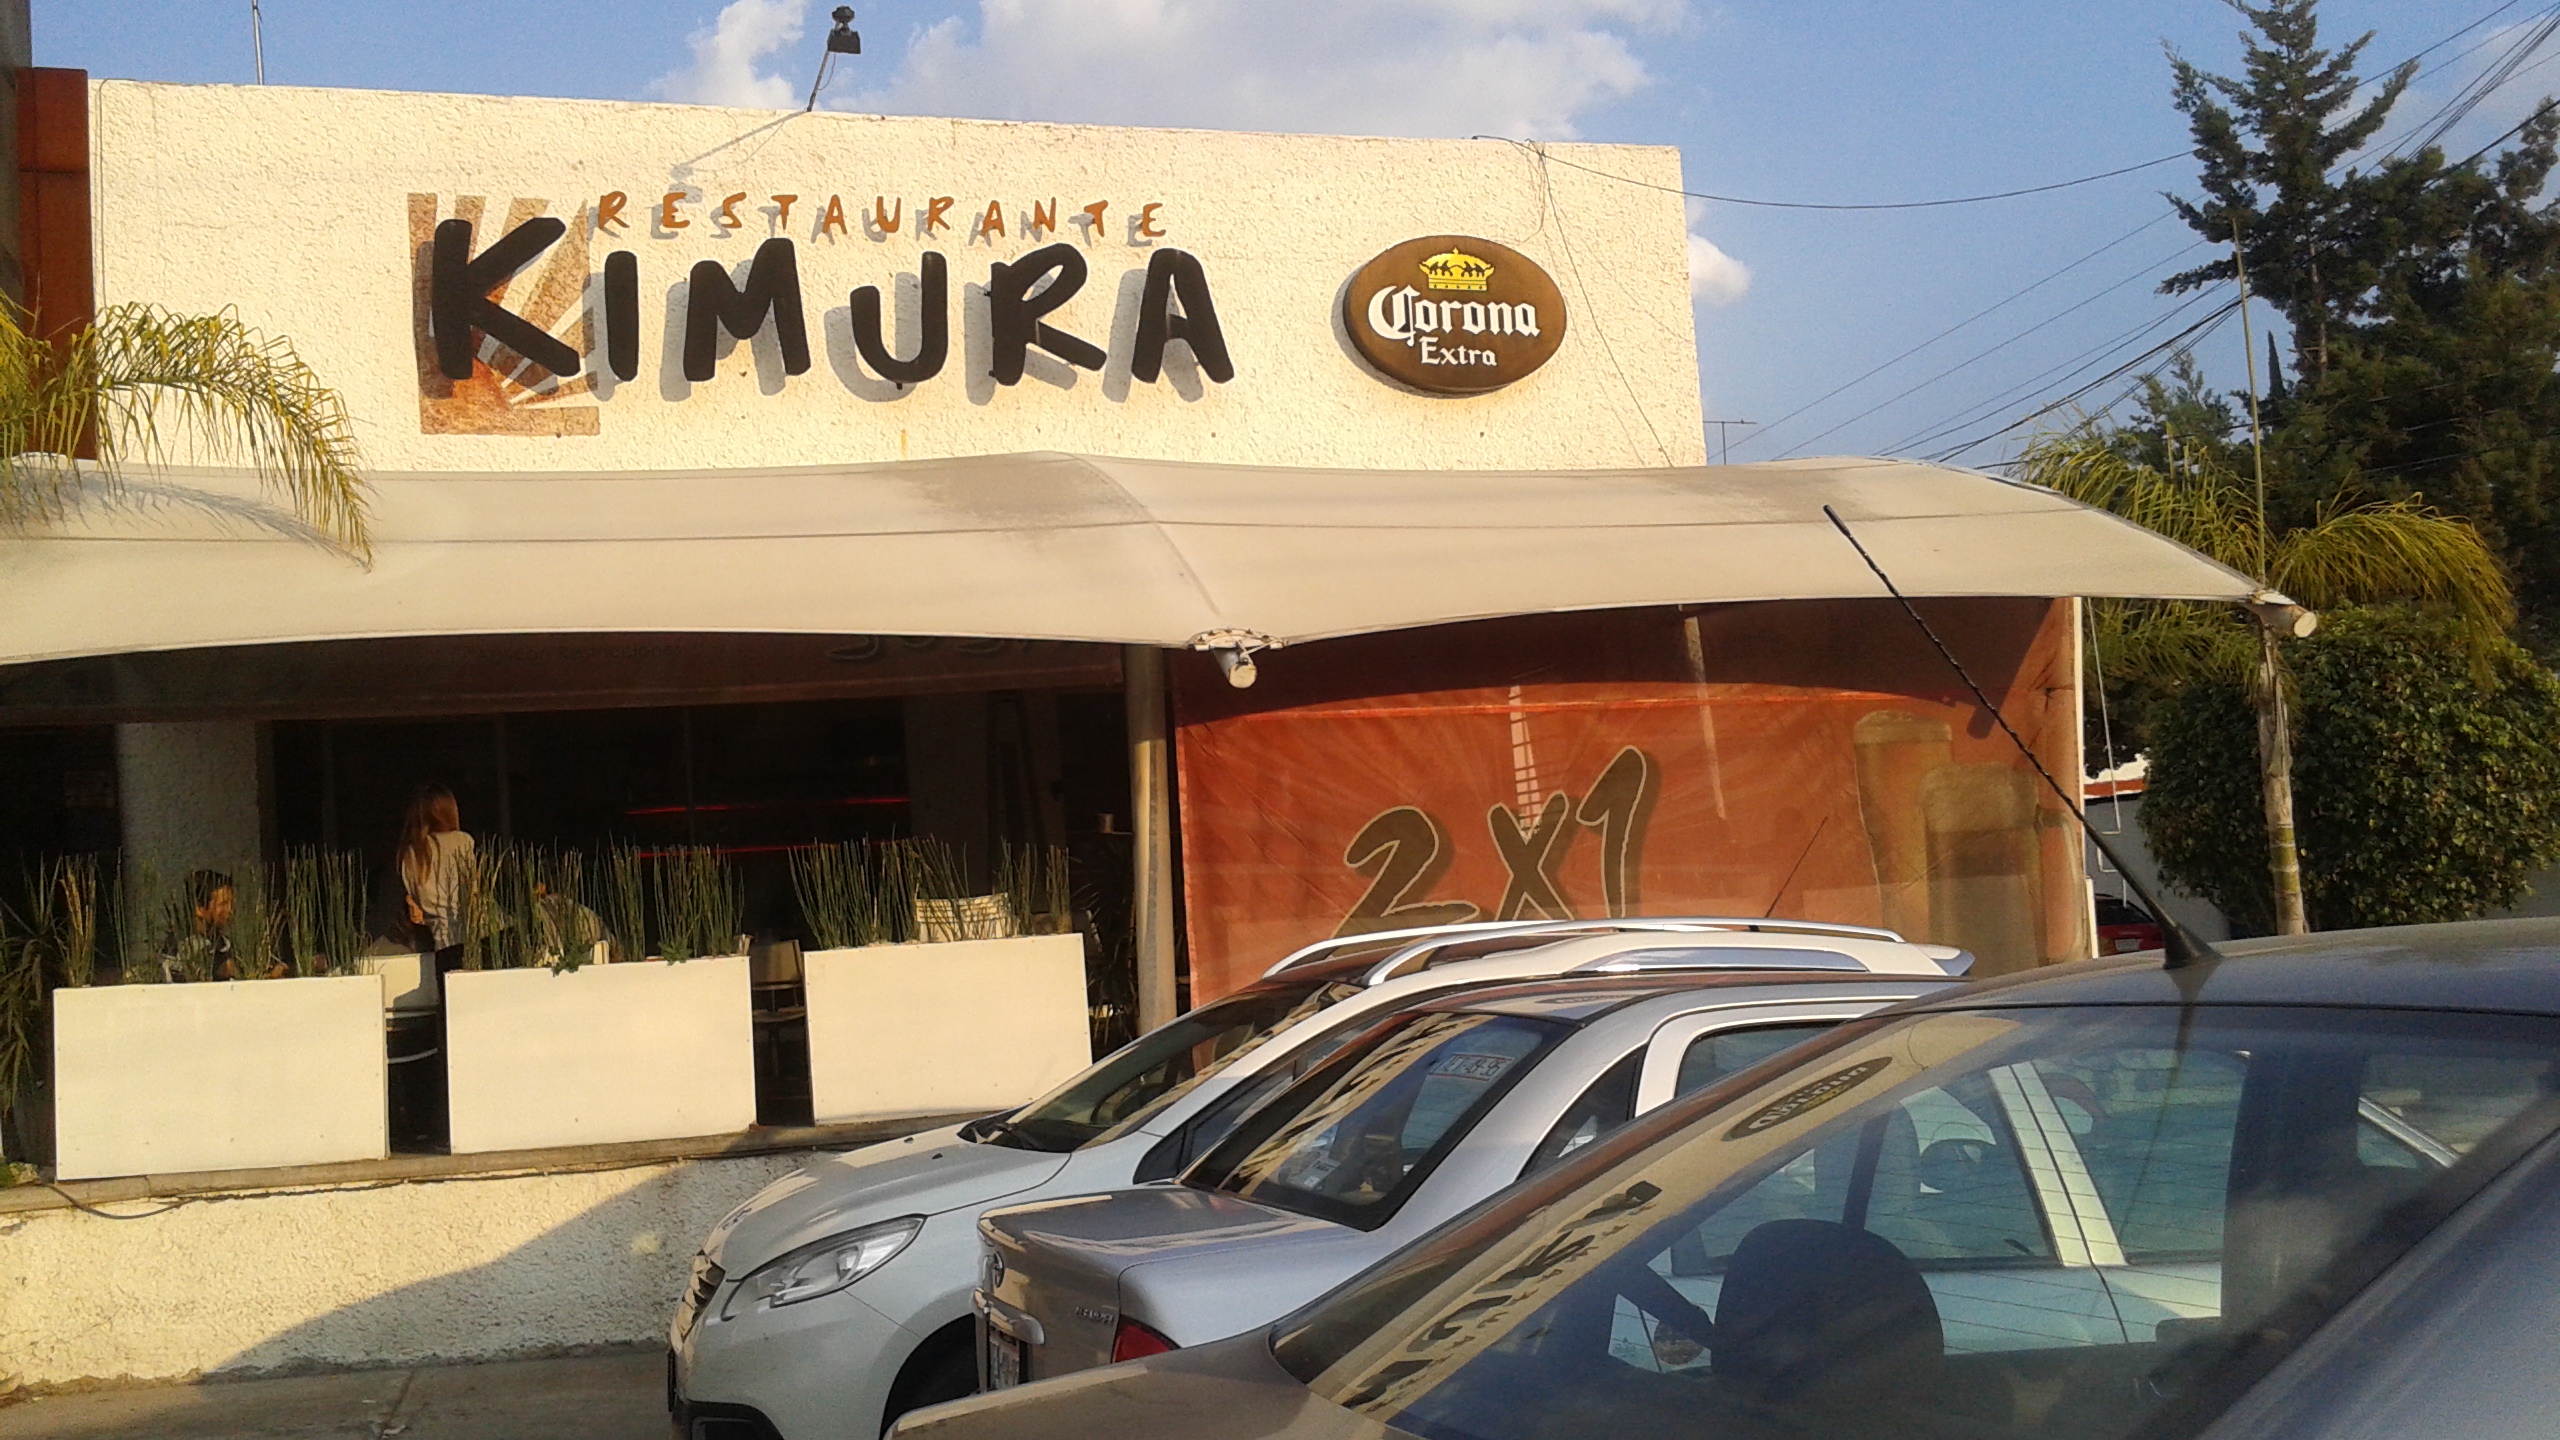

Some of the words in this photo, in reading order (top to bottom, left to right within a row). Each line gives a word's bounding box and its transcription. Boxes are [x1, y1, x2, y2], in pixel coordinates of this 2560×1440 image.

[598, 190, 1166, 238] RESTAURANTE
[432, 217, 1235, 387] KIMURA
[1367, 284, 1541, 347] Corona
[1419, 336, 1498, 367] Extra
